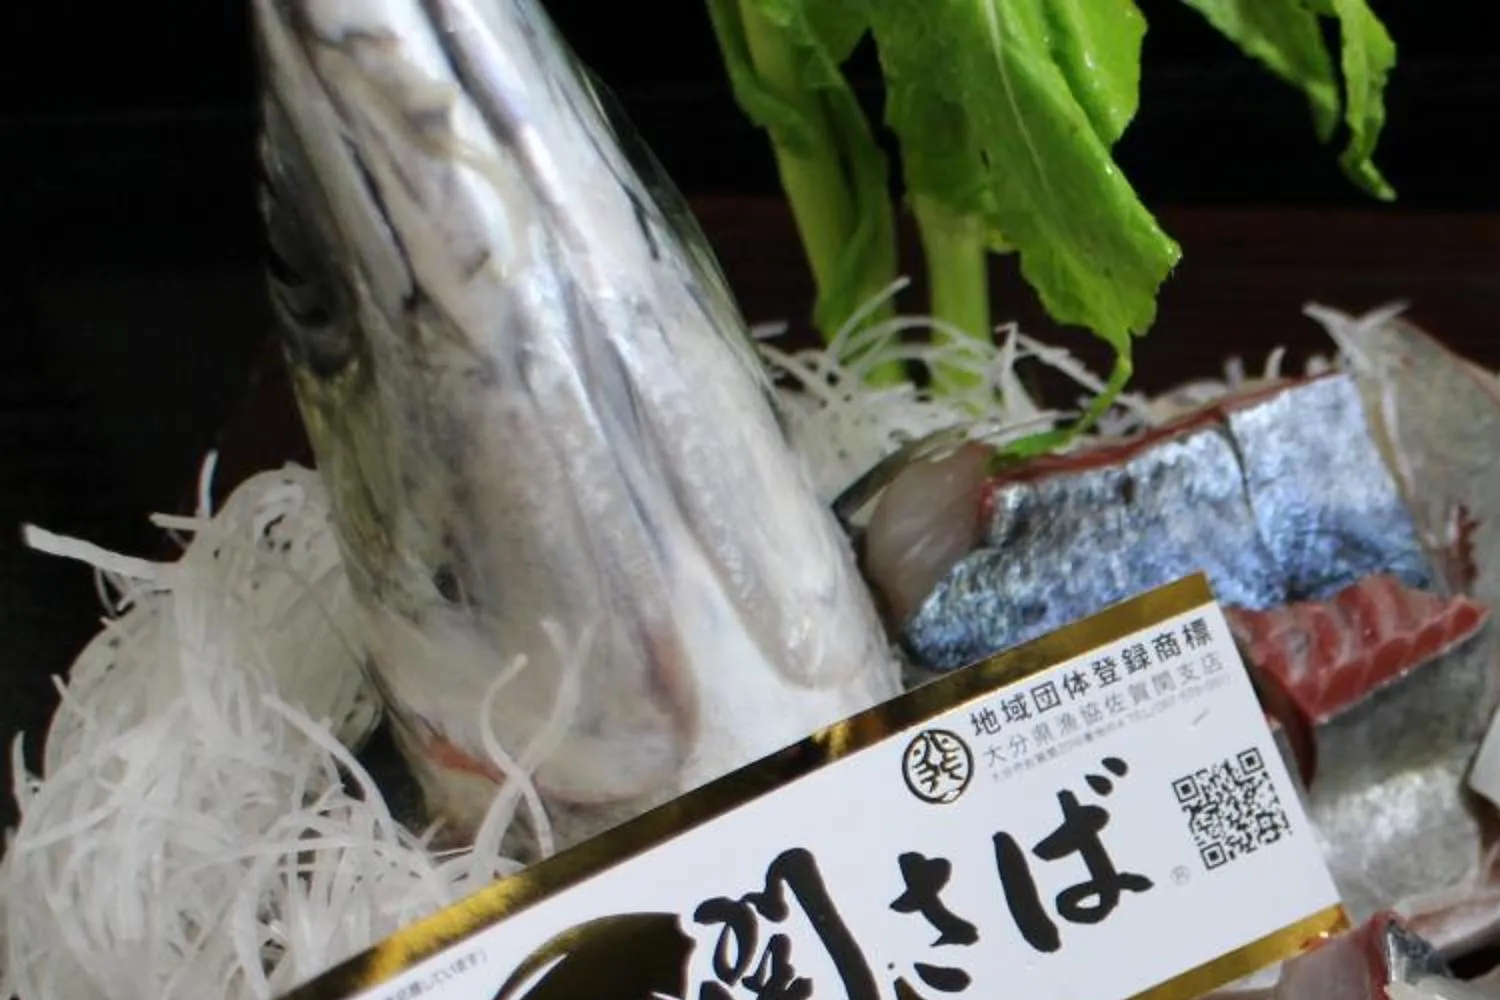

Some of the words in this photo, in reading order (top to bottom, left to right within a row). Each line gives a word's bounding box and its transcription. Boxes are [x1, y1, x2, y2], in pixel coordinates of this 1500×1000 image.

[971, 617, 1213, 736] 地域団体登録商標
